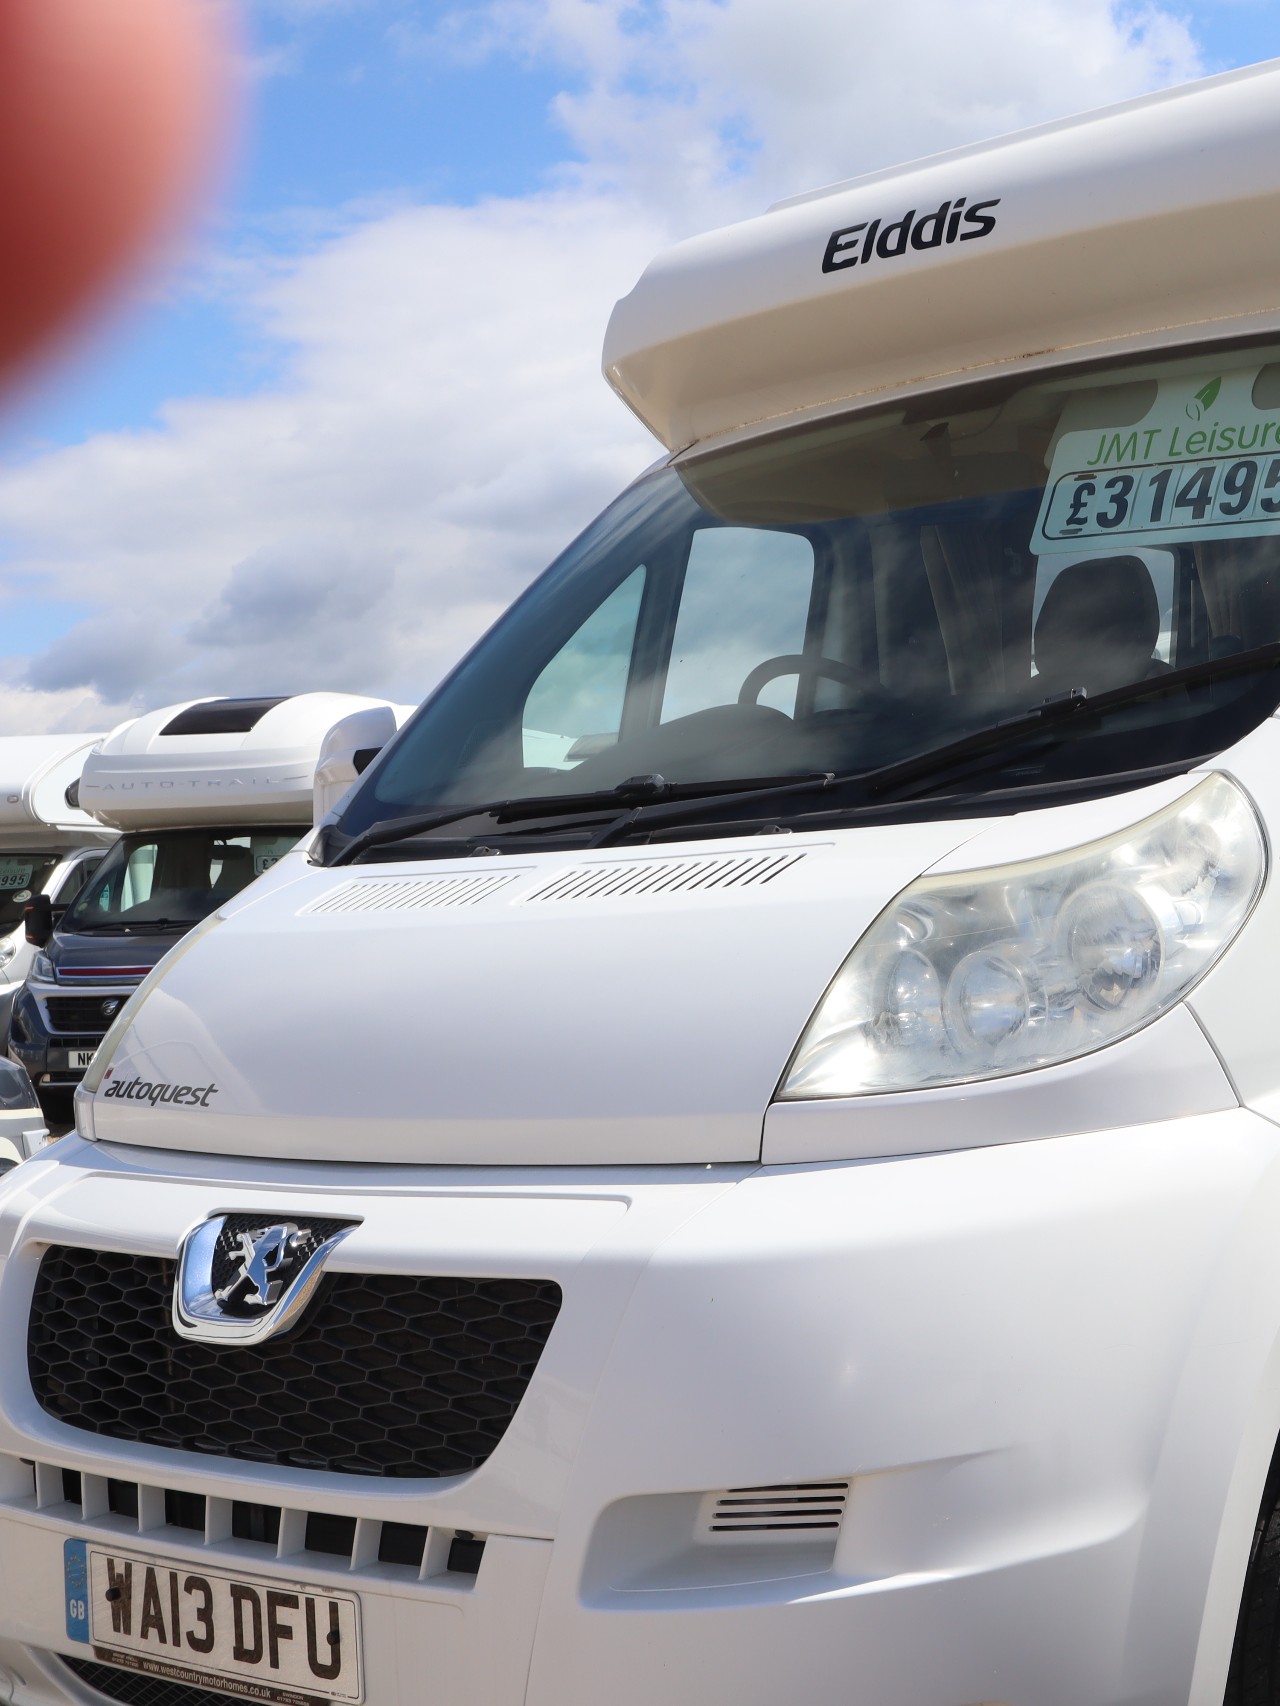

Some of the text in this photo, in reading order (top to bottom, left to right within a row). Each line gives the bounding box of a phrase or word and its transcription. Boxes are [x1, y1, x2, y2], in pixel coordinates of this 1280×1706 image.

[822, 197, 1001, 274] Elddis
[1087, 429, 1162, 466] JMT
[0, 875, 25, 886] 995
[78, 1052, 95, 1066] NK
[104, 1076, 219, 1107] autoquest
[70, 1599, 85, 1620] GB
[105, 1557, 342, 1681] WA13 DFU
[143, 1660, 271, 1698] www.westcountrymotorhomes.co.uk
